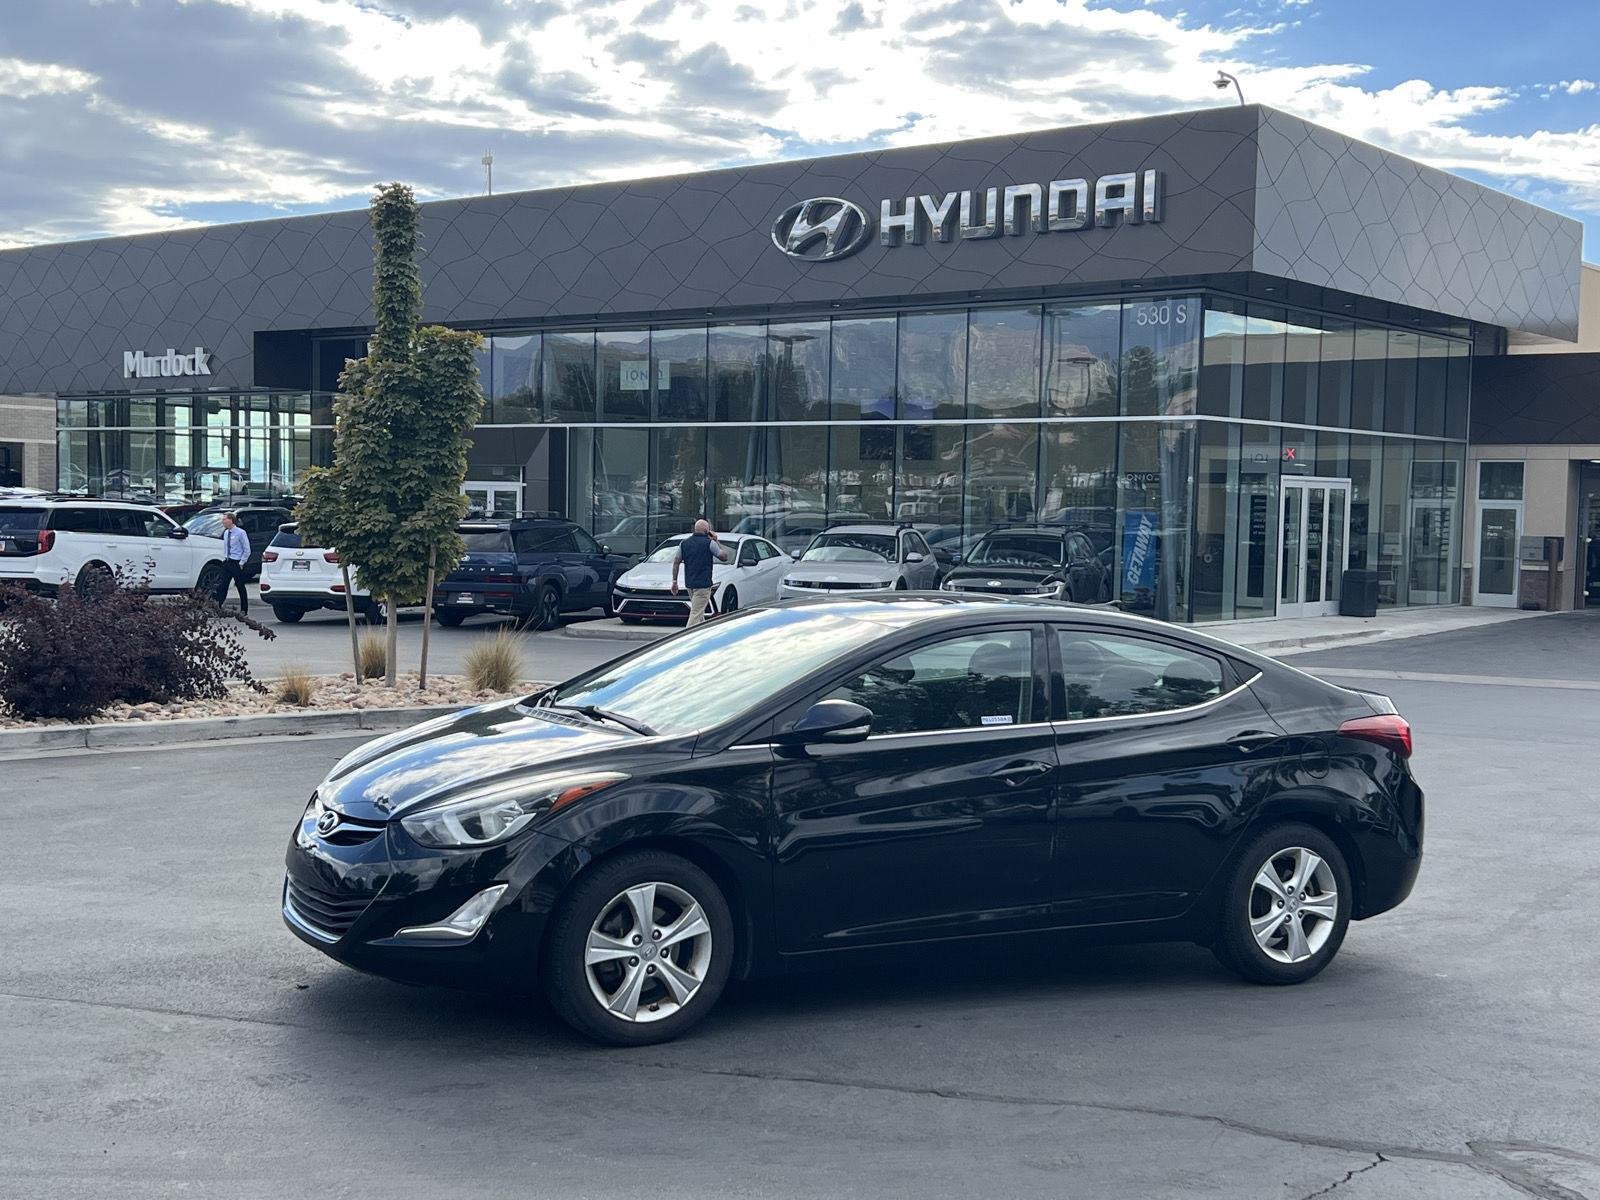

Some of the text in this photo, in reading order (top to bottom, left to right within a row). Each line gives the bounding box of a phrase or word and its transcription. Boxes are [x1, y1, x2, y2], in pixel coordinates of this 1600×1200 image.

[880, 169, 1159, 247] HYUNDAI
[1137, 304, 1187, 325] 530 S
[123, 347, 212, 378] Murdock
